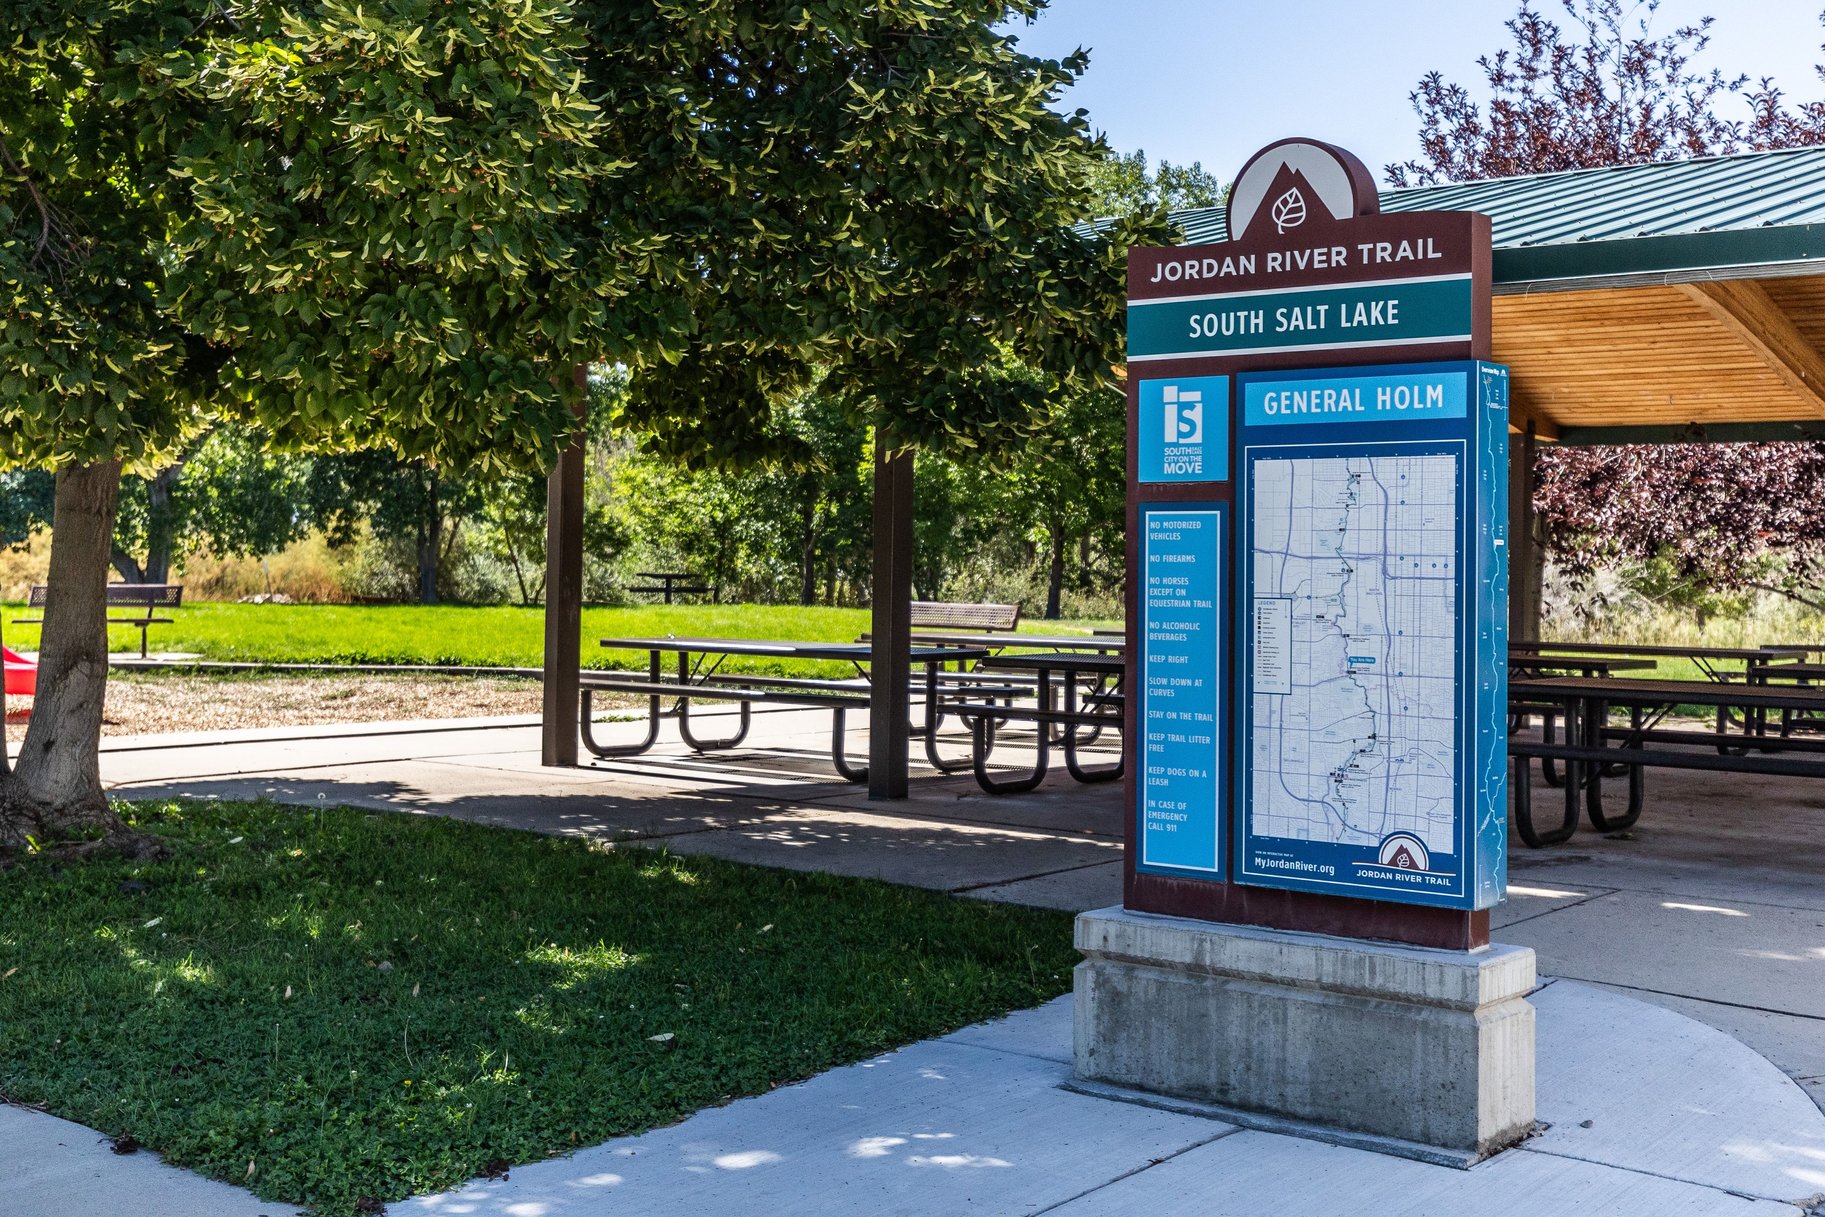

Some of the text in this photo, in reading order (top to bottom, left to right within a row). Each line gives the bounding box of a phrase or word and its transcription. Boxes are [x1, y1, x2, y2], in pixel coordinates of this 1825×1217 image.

[1150, 238, 1442, 283] JORDAN RIVER TRAIL
[1189, 300, 1399, 338] SOUTH SALT LAKE
[1264, 384, 1443, 415] GENERAL HOLM
[1164, 447, 1192, 456] SOUTH
[1164, 462, 1202, 474] MOVE
[1150, 521, 1201, 529] NO MOTORIZED
[1150, 577, 1189, 585] NO HORSES
[1149, 588, 1173, 596] EXCEPT
[1149, 599, 1212, 608] EQUESTRIAN TRAIL
[1162, 622, 1200, 630] ALCOHOLIC
[1149, 633, 1187, 641] BEVERAGES
[1149, 655, 1188, 664] KEEP RIGHT
[1149, 677, 1203, 687] SLOW DOWN AT
[1149, 688, 1175, 697] CURVES
[1149, 711, 1214, 721] STAY ON THE TRAIL
[1149, 733, 1211, 744] KEEP TRAIL LITTER
[1149, 744, 1164, 752] FREE
[1148, 766, 1207, 778] KEEP DOGS ON A
[1148, 777, 1169, 786] LEASH
[1148, 800, 1187, 810] IN CASE OF
[1148, 811, 1188, 821] EMERGENCY
[1148, 822, 1177, 832] CALL 911
[1254, 857, 1335, 876] MyJordanRiver.org
[1356, 869, 1452, 886] JORDAN RIVER TRAIL
